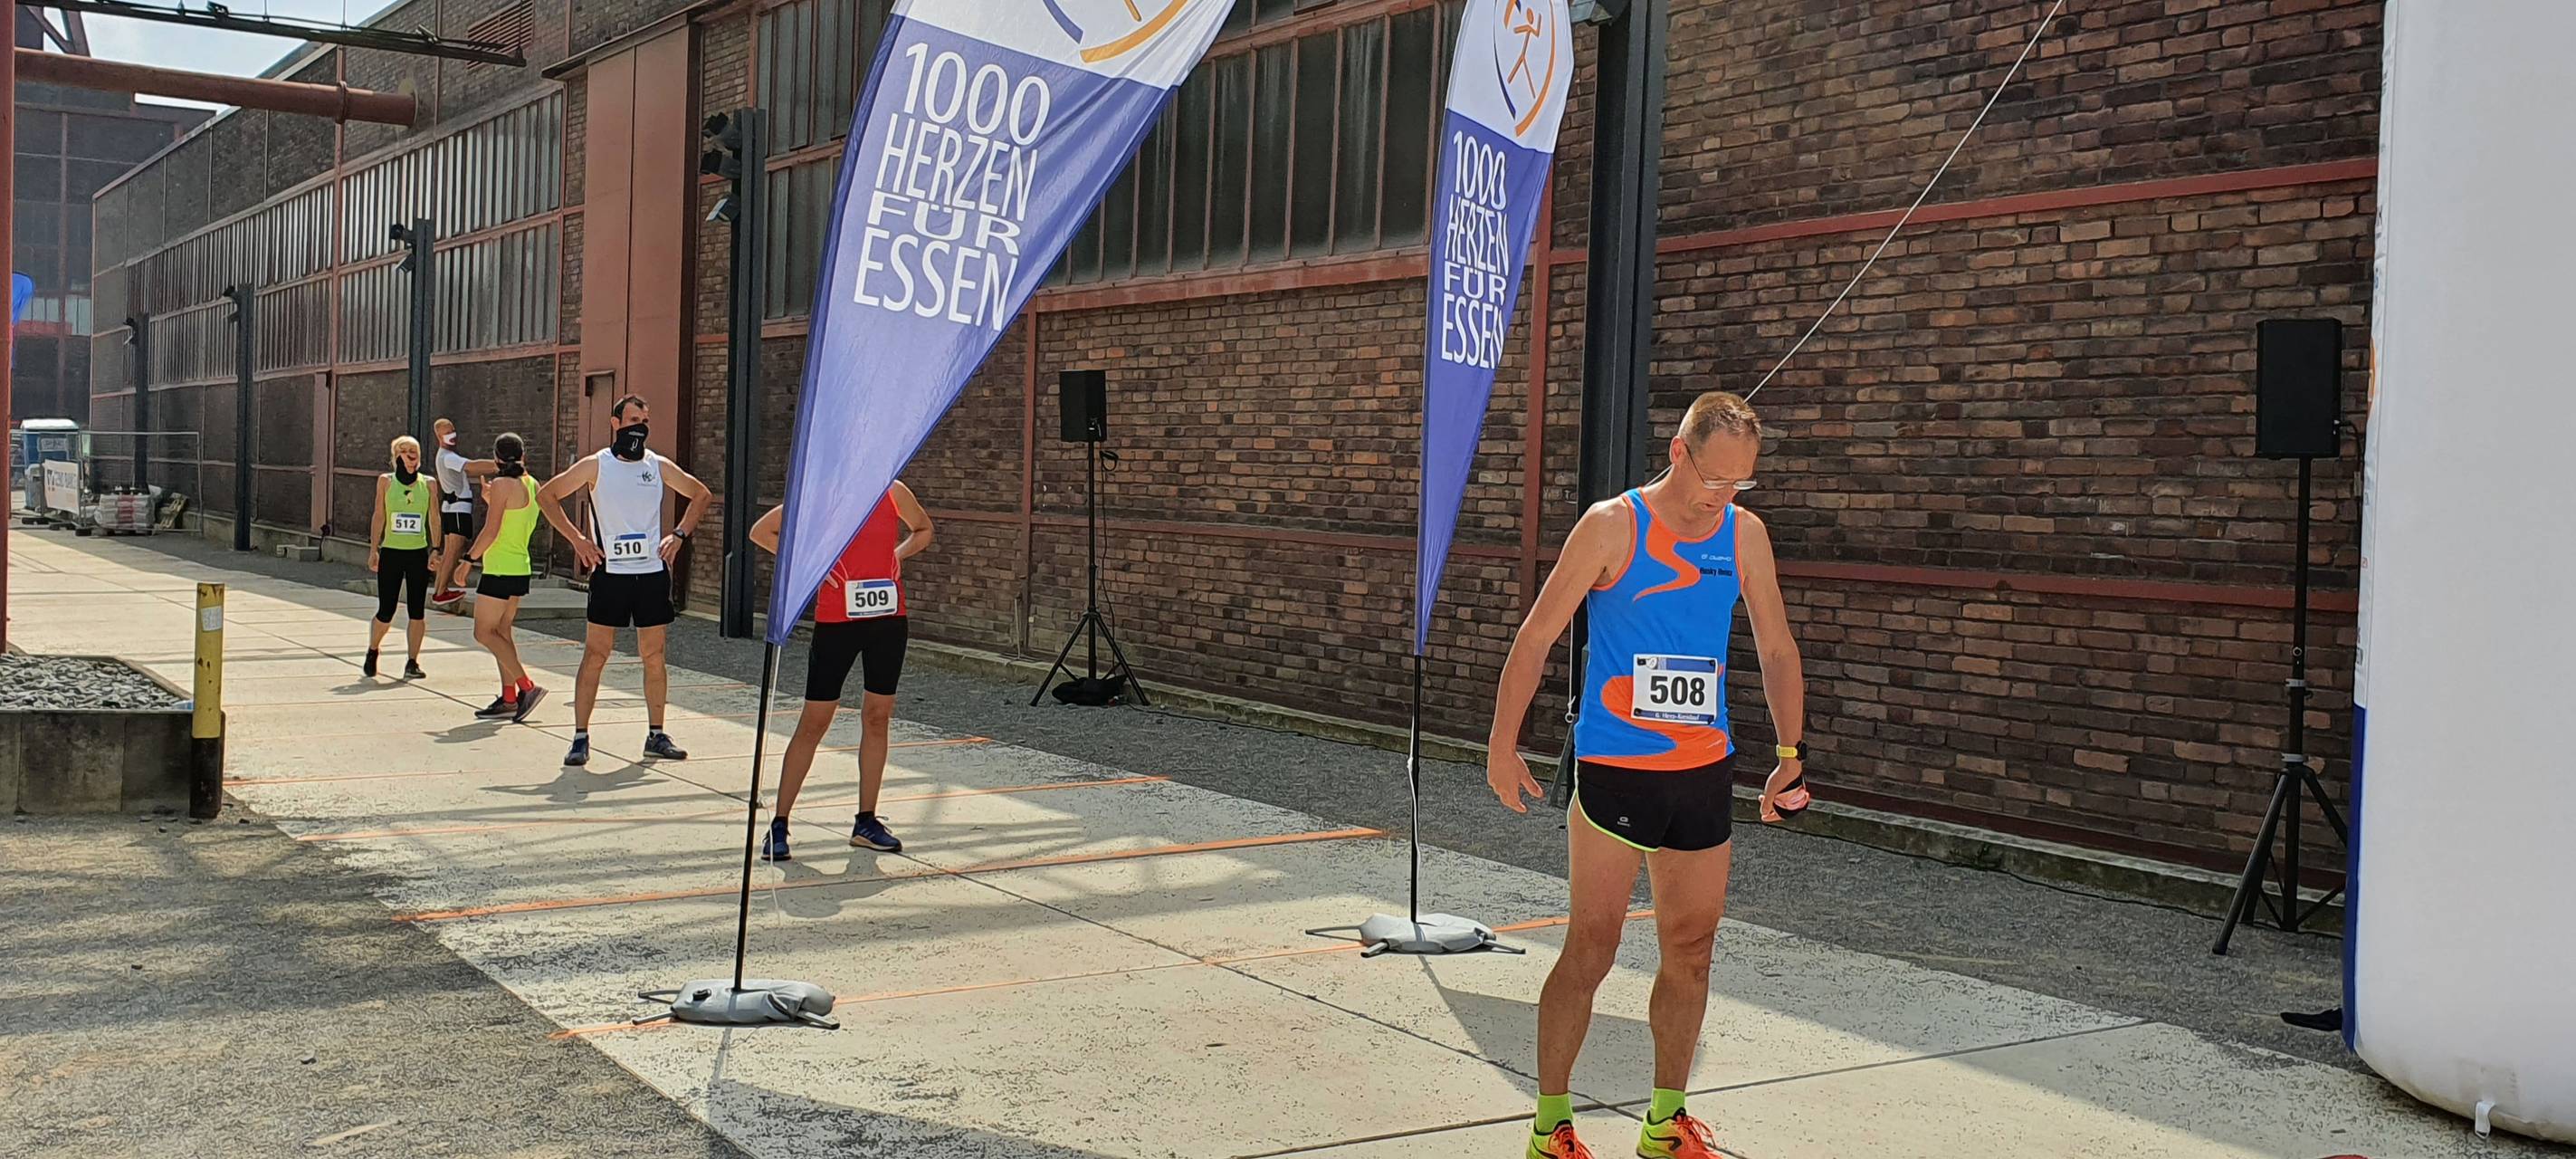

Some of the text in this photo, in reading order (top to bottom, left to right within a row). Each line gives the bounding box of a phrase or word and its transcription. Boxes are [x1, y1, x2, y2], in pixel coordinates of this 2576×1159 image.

[903, 42, 1051, 146] 1000
[874, 112, 1038, 223] HERZEN
[1453, 129, 1507, 211] 1000
[866, 189, 1021, 256] FÜR
[1445, 194, 1510, 277] HERZEN
[853, 226, 1018, 332] ESSEN
[1444, 261, 1507, 306] FÜR
[1441, 293, 1503, 369] ESSEN
[396, 518, 416, 529] 512
[614, 541, 642, 555] 510
[854, 589, 889, 608] 509
[1650, 675, 1705, 706] 508
